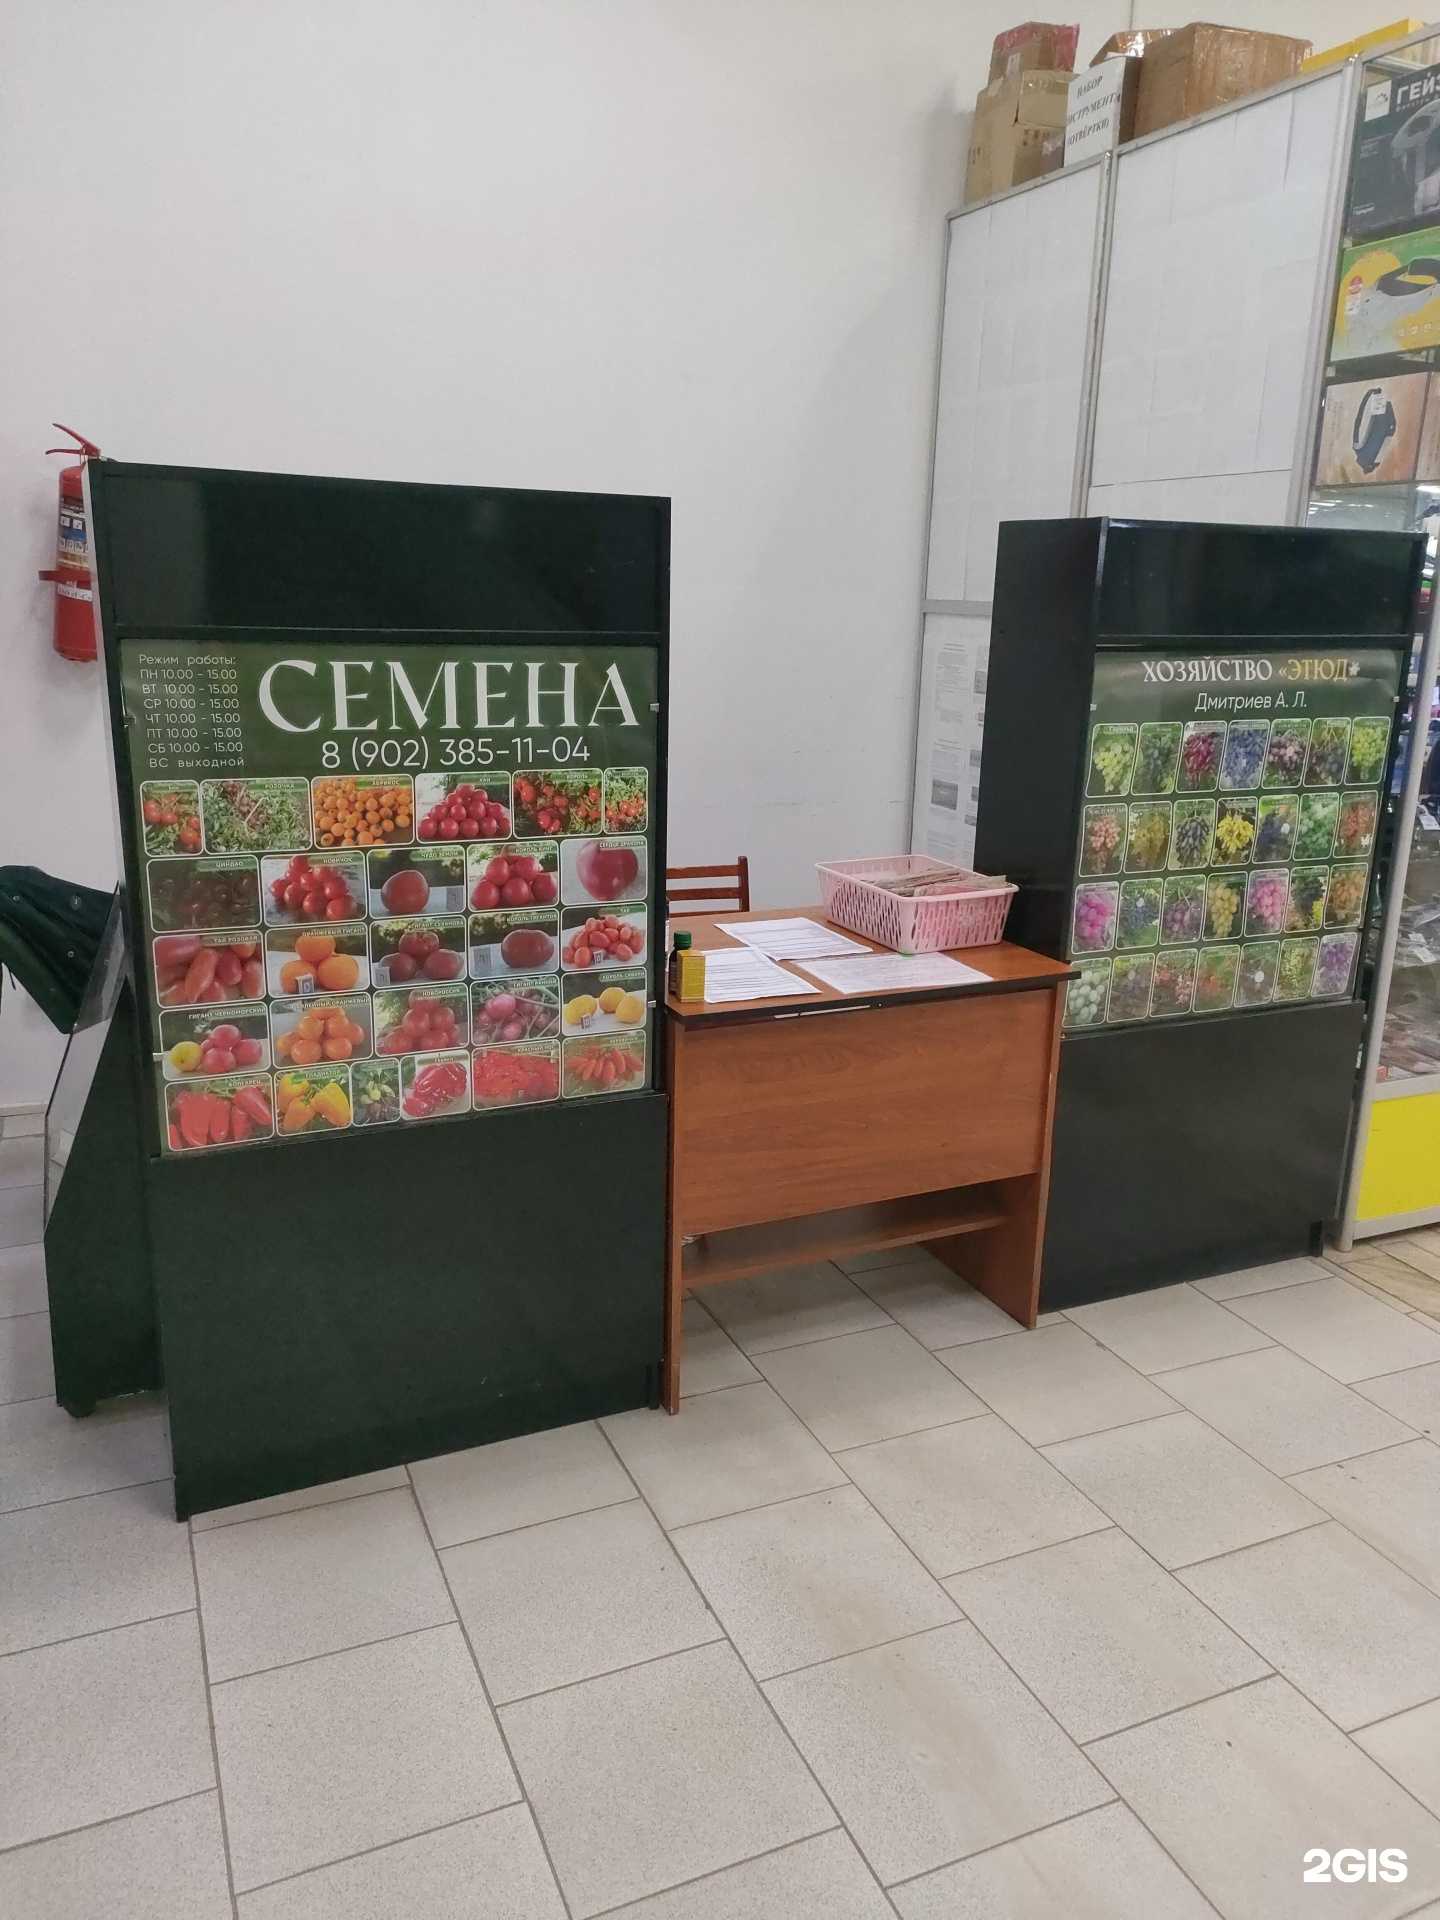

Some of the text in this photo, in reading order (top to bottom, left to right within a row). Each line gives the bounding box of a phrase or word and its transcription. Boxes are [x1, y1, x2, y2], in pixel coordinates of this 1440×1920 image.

[139, 654, 236, 666] Режим работы:
[140, 669, 158, 679] ПН
[161, 669, 194, 679] 10.00
[207, 669, 237, 679] 15.00
[1142, 656, 1273, 682] ХОЗЯЙСТВО
[142, 684, 157, 694] ВТ
[164, 684, 195, 694] 10.00
[208, 684, 238, 694] 15.00
[258, 659, 640, 733] СЕМЕНА
[143, 698, 162, 709] СР
[164, 698, 196, 708] 10.00
[209, 698, 239, 708] 15.00
[1194, 691, 1307, 713] Дмитриев А. Л.
[145, 713, 161, 723] ЧТ
[164, 713, 196, 723] 10.00
[210, 713, 240, 723] 15.00
[147, 729, 162, 738] ПТ
[166, 728, 198, 738] 10.00
[212, 728, 242, 738] 15.00
[148, 743, 165, 753] СБ
[168, 742, 200, 753] 10.00
[214, 742, 243, 752] 15.00
[321, 735, 591, 771] 8 (902) 385-11-04
[149, 757, 245, 768] ВС выходной
